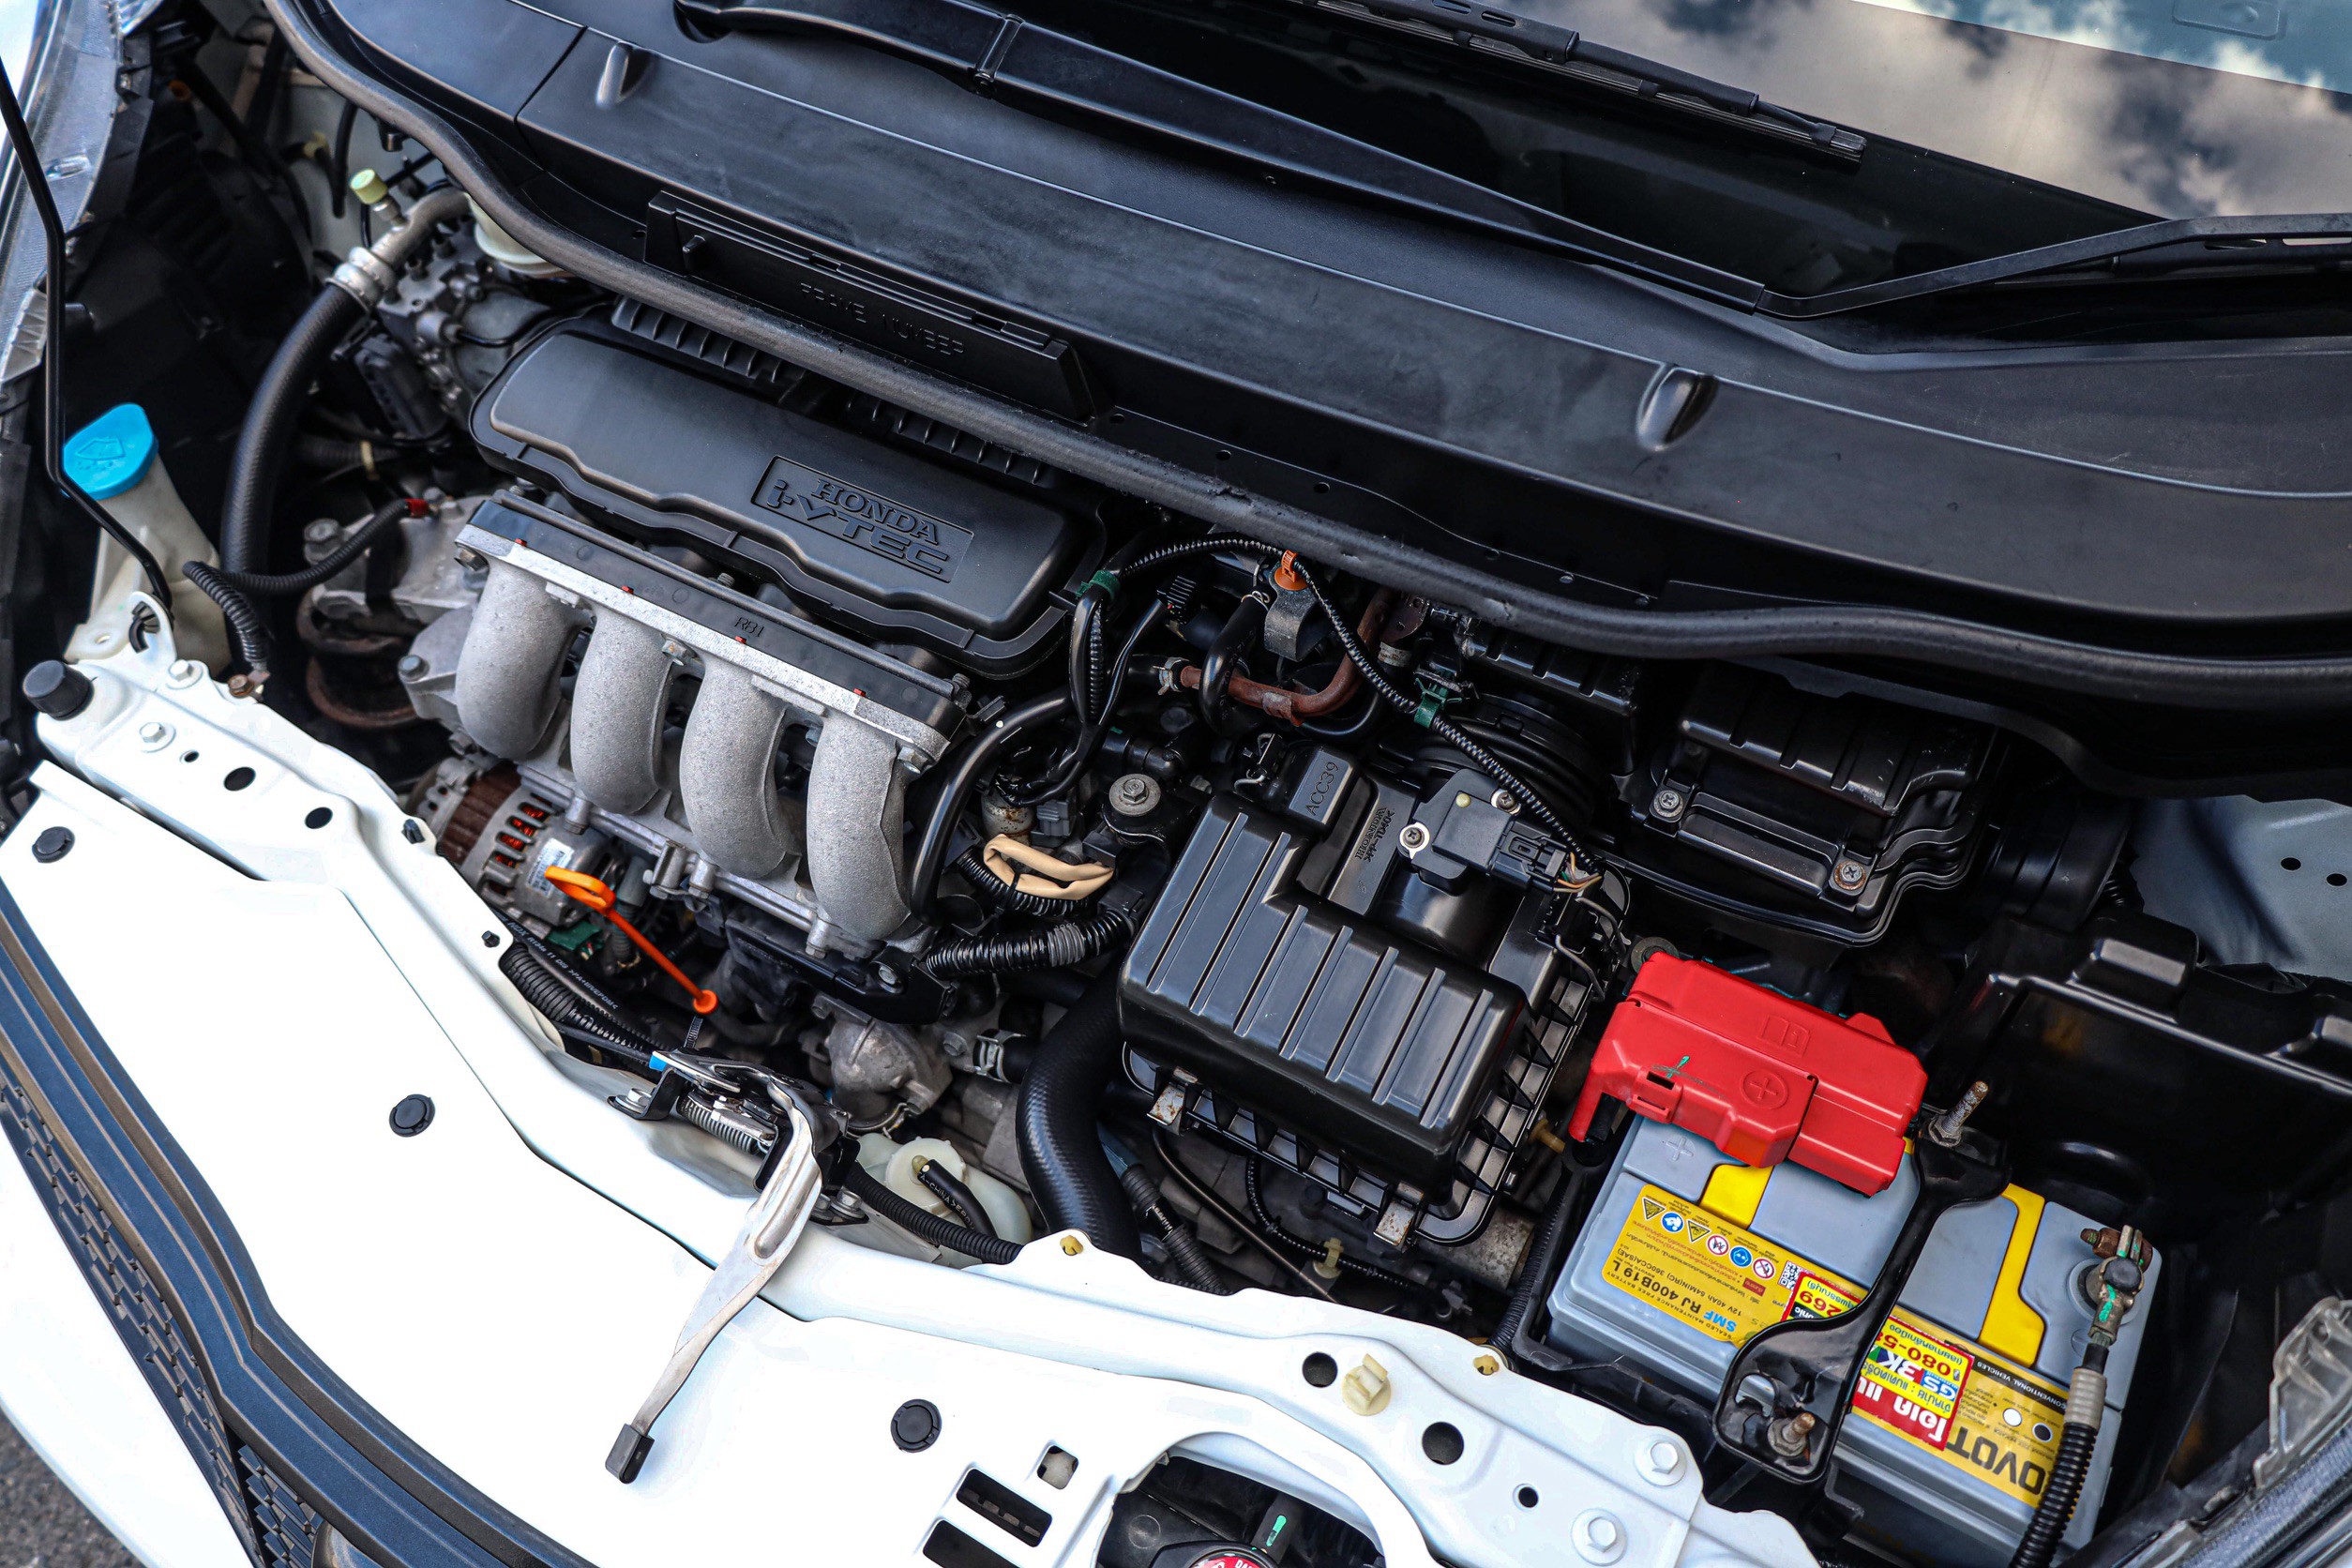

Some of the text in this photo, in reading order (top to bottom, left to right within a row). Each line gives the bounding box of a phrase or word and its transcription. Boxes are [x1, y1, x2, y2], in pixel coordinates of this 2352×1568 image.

[765, 477, 949, 574] i-VTEC
[809, 477, 939, 546] HONDA
[733, 616, 764, 637] RB1
[1304, 761, 1338, 816] ACC39
[1354, 807, 1387, 859] HONDA
[1606, 1270, 1636, 1289] BATTERY
[1616, 1246, 1743, 1317] 12V 40Ah 54MIN(RC) 360CCA(SAE)
[1636, 1285, 1655, 1298] FREE
[1612, 1259, 1738, 1333] SMF RJ 400B19 L
[1654, 1295, 1704, 1324] MAINTENANCE
[1876, 1349, 1922, 1381] 3K
[1976, 1360, 2012, 1381] VEHICLES
[1915, 1388, 1951, 1412] จำหน่าย
[1920, 1373, 1958, 1401] GS
